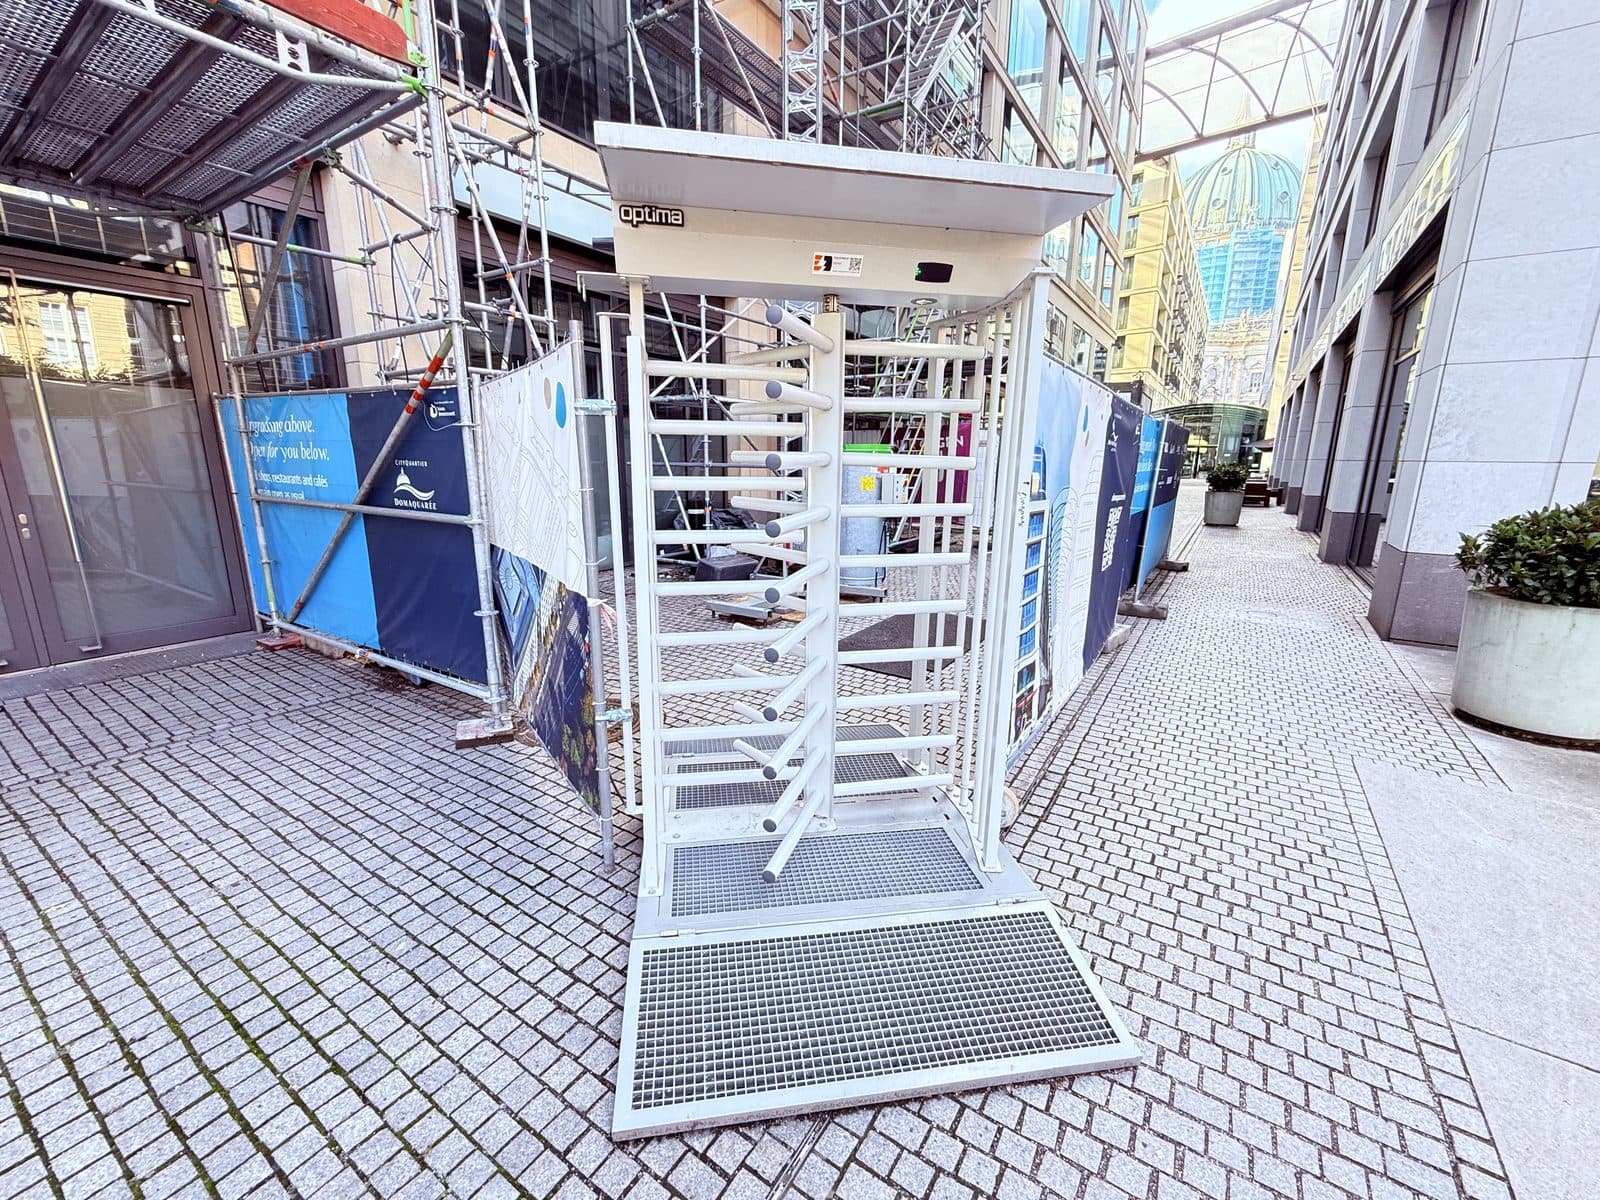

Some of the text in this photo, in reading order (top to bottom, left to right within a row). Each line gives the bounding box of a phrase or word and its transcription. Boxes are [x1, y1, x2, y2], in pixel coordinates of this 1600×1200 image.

[620, 205, 684, 226] optima
[284, 414, 316, 433] above.
[266, 441, 278, 463] for
[280, 446, 300, 464] you
[300, 441, 330, 462] below.
